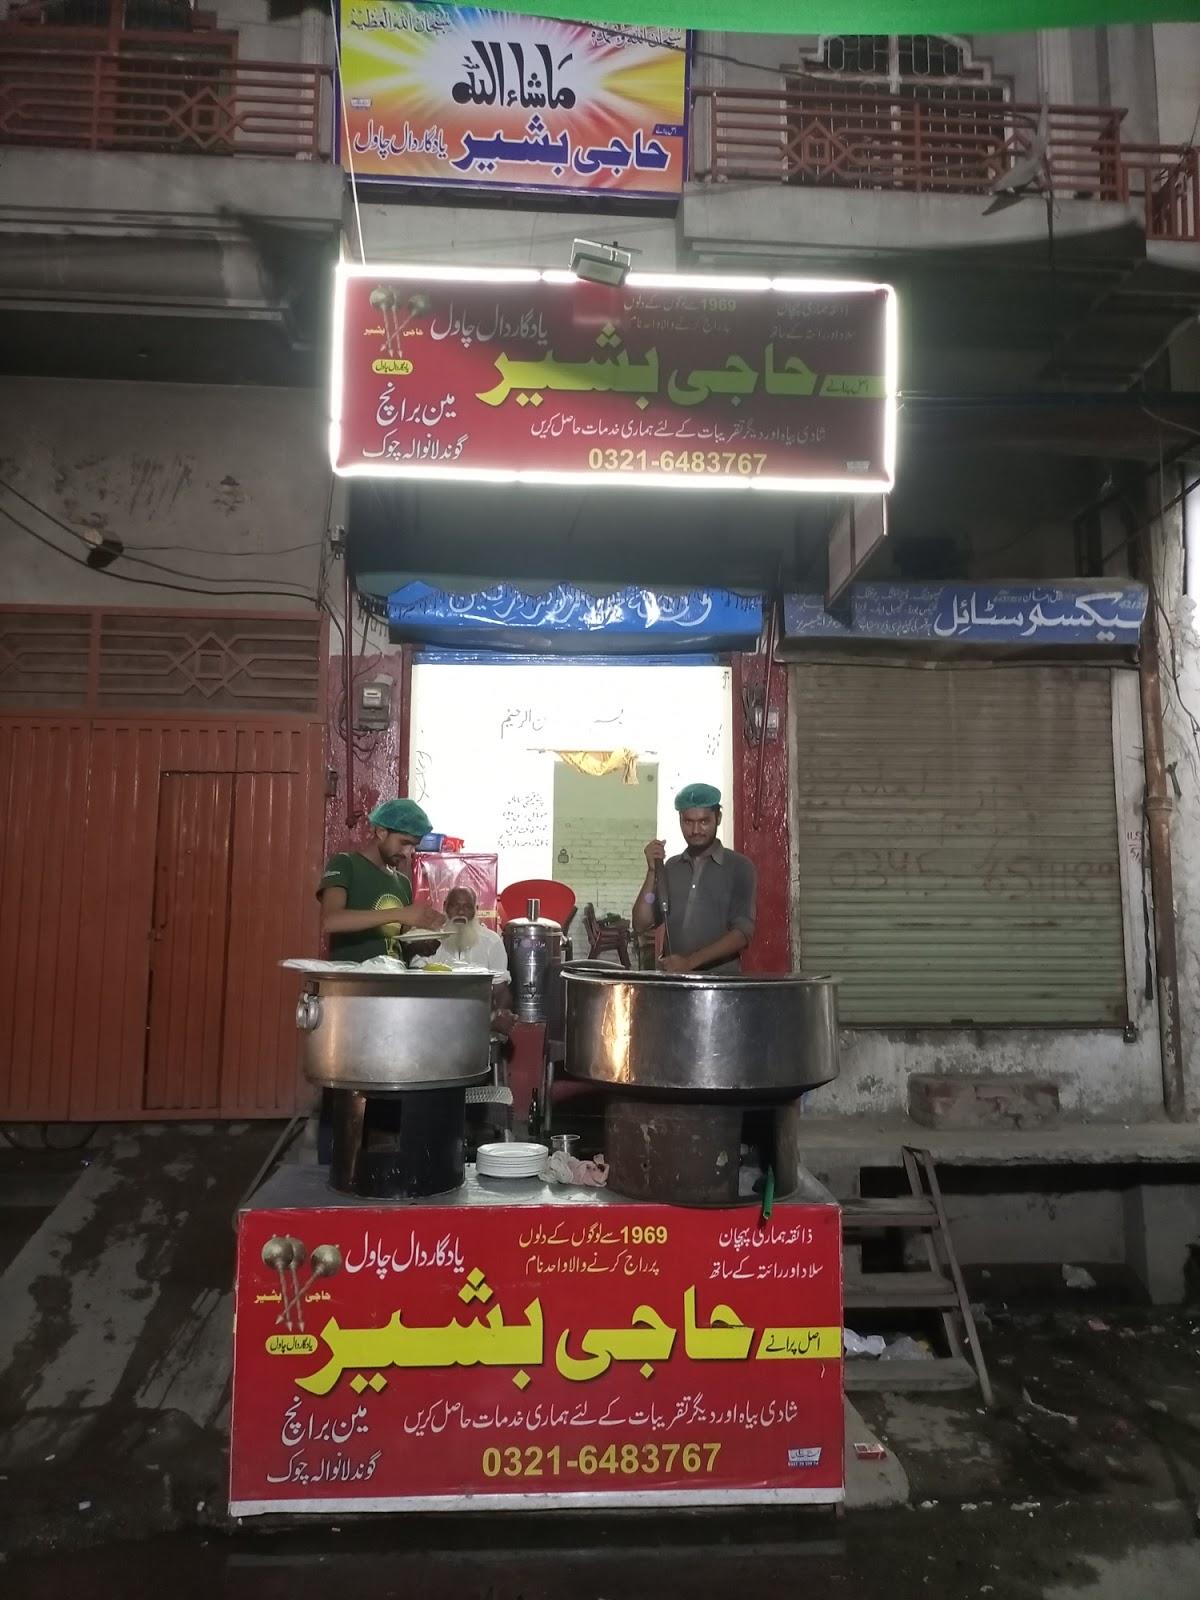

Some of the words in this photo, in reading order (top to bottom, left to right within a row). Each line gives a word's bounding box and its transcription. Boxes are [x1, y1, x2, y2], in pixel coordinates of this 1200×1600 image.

[353, 118, 391, 161] چاول
[449, 113, 571, 177] بشیر
[572, 128, 671, 177] حاجی
[430, 299, 476, 349] چاول
[476, 303, 511, 342] دال
[475, 322, 659, 411] بشیر
[667, 342, 818, 406] حاجی
[376, 381, 421, 427] برانچ
[422, 392, 457, 427] مین
[530, 411, 561, 439] کریں
[551, 413, 581, 438] حاصل
[581, 418, 621, 437] خدمات
[620, 419, 654, 439] ہماری
[675, 417, 697, 438] کے
[362, 428, 401, 461] چوک
[588, 447, 768, 476] 0321-6483767
[518, 1222, 548, 1249] دلوں
[547, 1220, 571, 1245] کے
[571, 1221, 602, 1248] لوگوں
[600, 1230, 622, 1245] سے
[620, 1225, 669, 1245] 1969
[718, 1226, 752, 1253] پہچان
[752, 1224, 787, 1249] ہماری
[785, 1223, 814, 1246] ذائقہ
[345, 1230, 392, 1281] چاول
[391, 1229, 428, 1273] دال
[427, 1232, 465, 1274] یادگار
[543, 1256, 568, 1274] واحد
[568, 1254, 587, 1273] والا
[586, 1249, 628, 1274] کرنے
[524, 1254, 545, 1277] نام
[709, 1259, 734, 1280] ساتھ
[732, 1255, 756, 1279] کے
[782, 1261, 801, 1279] اور
[800, 1261, 824, 1279] سلاد
[254, 1288, 283, 1305] بشیر
[305, 1289, 332, 1304] حاجی
[294, 1266, 545, 1395] بشیر
[555, 1284, 756, 1383] حاجی
[797, 1331, 821, 1353] اصل
[764, 1334, 799, 1356] پرانے
[281, 1395, 331, 1447] برانچ
[403, 1399, 445, 1437] کریں
[430, 1400, 472, 1433] حاصل
[472, 1403, 525, 1429] خدمات
[525, 1402, 569, 1431] ہماری
[569, 1400, 598, 1426] لئے
[598, 1395, 627, 1426] کے
[628, 1395, 692, 1431] تقریبات
[686, 1391, 716, 1425] دیگر
[715, 1403, 738, 1425] اور
[739, 1399, 759, 1430] بیاہ
[761, 1398, 799, 1427] شادی
[332, 1404, 369, 1444] مین
[266, 1447, 309, 1486] چوک
[482, 1441, 722, 1479] 0321-6483767
